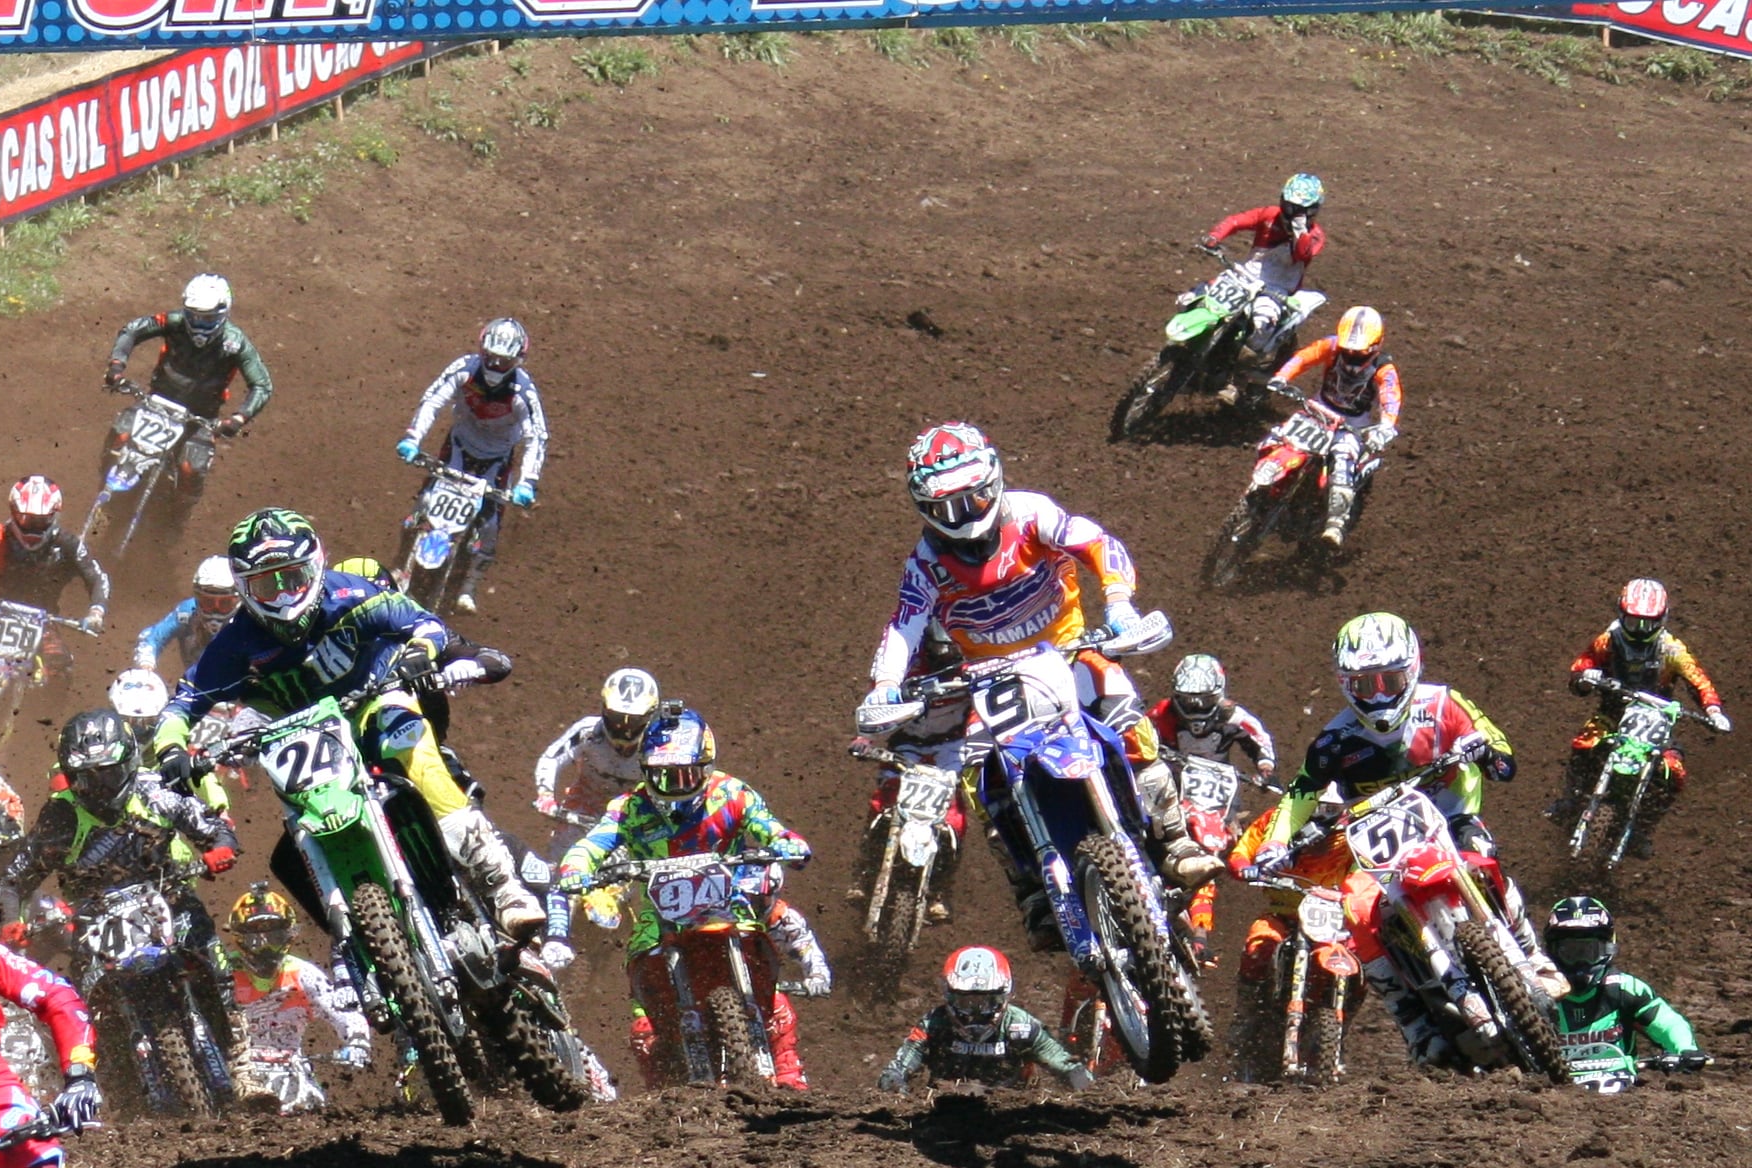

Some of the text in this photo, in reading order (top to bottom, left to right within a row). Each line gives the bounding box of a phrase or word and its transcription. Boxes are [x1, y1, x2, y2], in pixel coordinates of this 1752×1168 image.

[120, 46, 266, 157] LUCAS OIL
[59, 98, 106, 180] OIL
[133, 417, 177, 450] 722
[1285, 418, 1328, 453] 140
[429, 494, 474, 526] 869
[984, 603, 1060, 645] YAMAHA
[392, 720, 418, 740] thor
[277, 732, 344, 794] 24
[901, 781, 950, 816] 224
[1367, 801, 1428, 865] 54
[659, 875, 725, 920] 94
